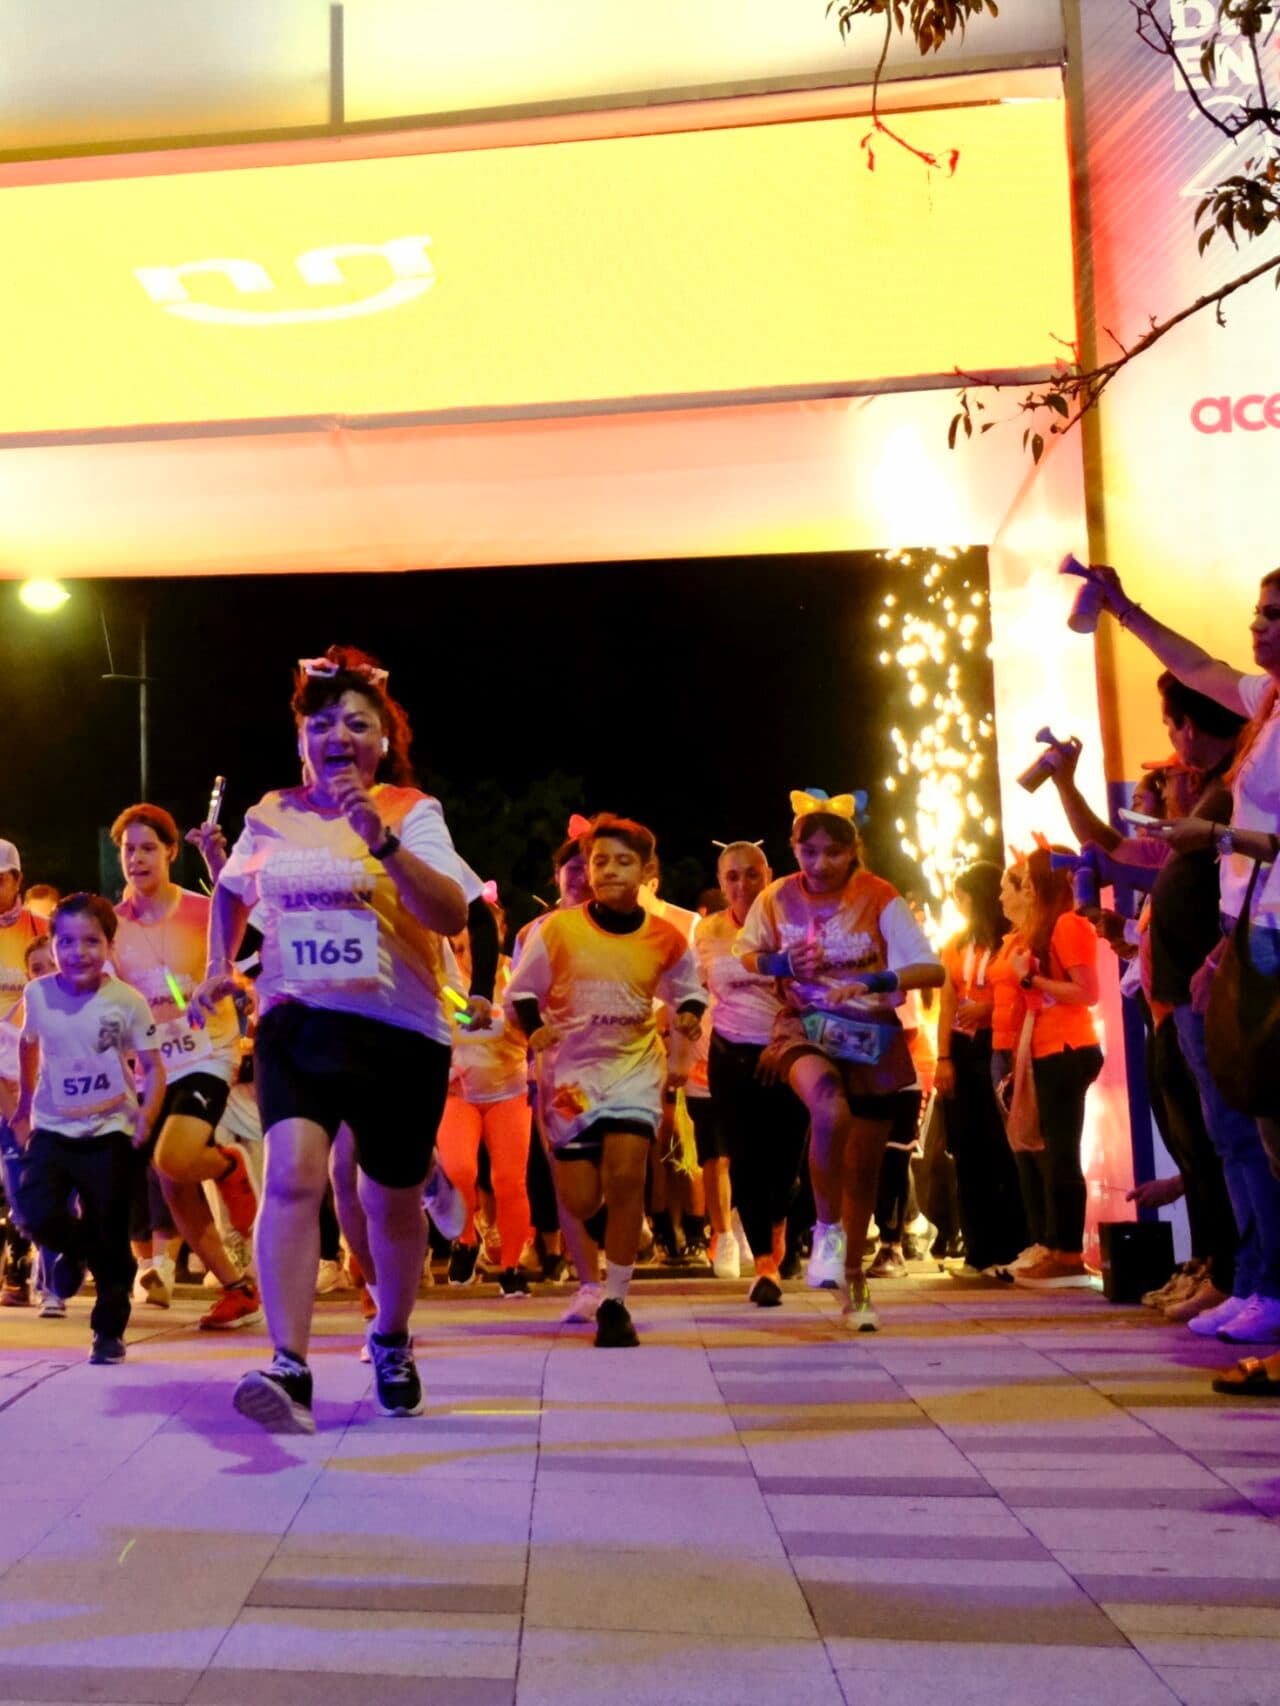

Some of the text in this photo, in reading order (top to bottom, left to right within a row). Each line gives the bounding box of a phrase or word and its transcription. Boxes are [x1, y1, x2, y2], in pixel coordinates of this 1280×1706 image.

[1173, 41, 1259, 92] EN
[282, 889, 373, 910] ZAPOPAN
[291, 938, 363, 966] 1165
[161, 1034, 196, 1058] 915
[63, 1072, 111, 1096] 574
